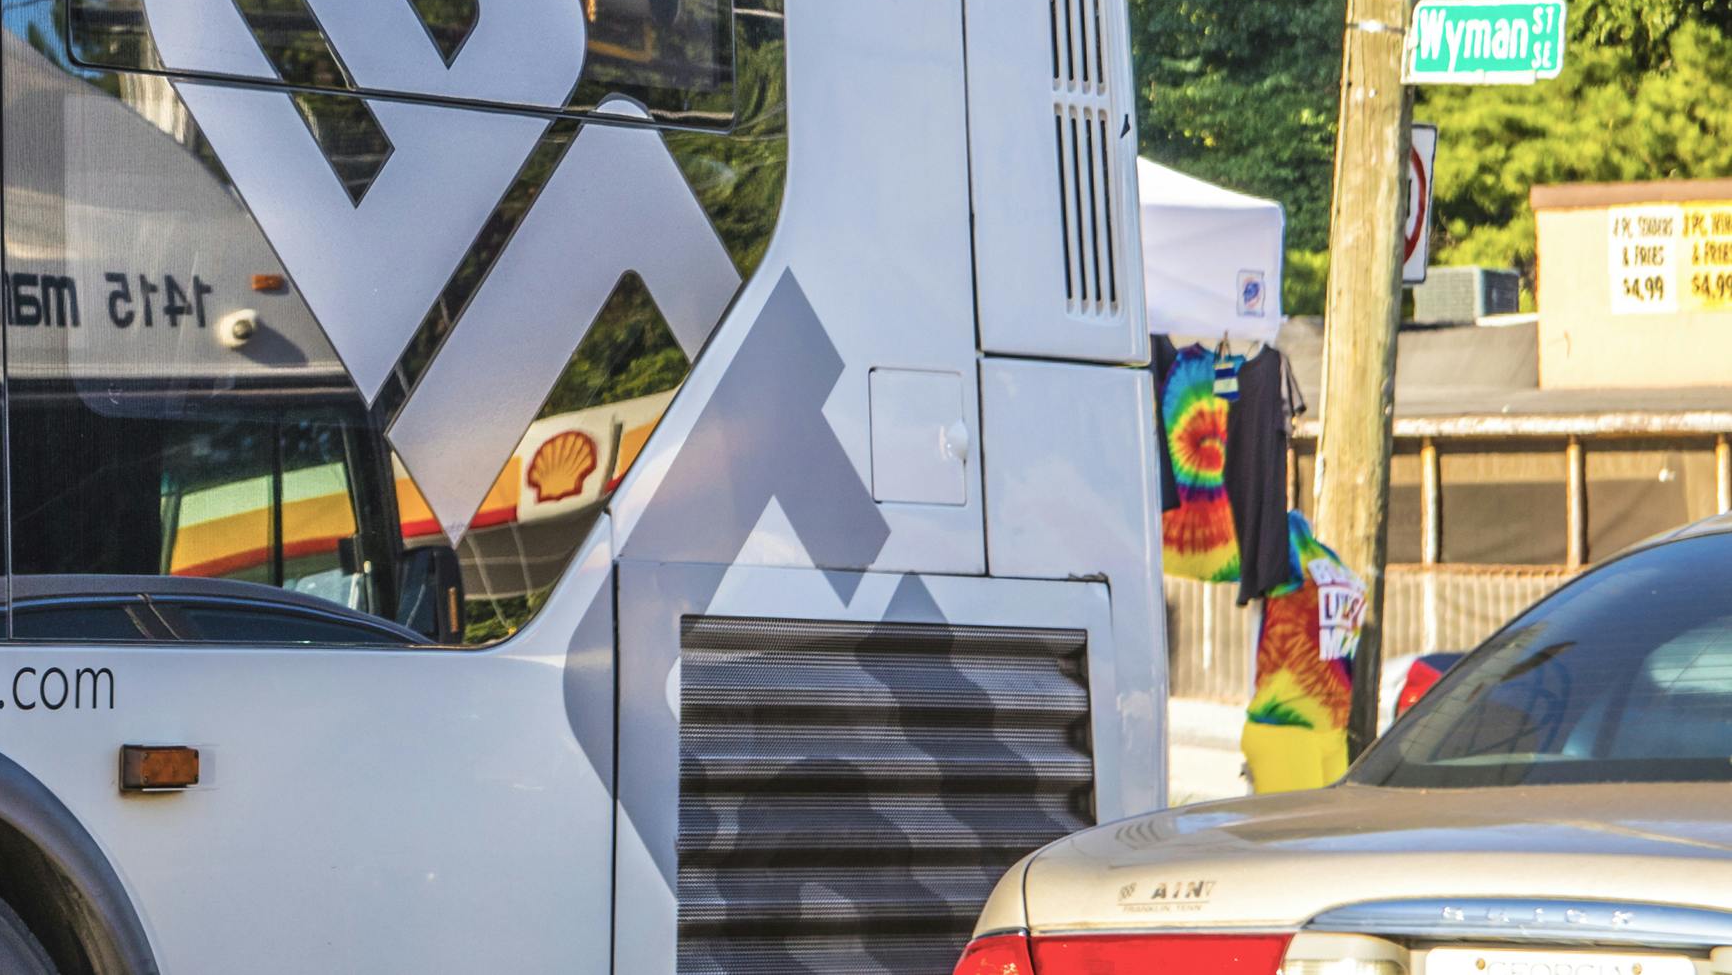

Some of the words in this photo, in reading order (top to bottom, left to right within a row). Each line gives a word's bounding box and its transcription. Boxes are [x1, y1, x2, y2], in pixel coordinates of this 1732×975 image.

[1420, 8, 1528, 74] Wyman
[1532, 6, 1554, 34] ST
[1531, 41, 1552, 69] SE
[1634, 244, 1664, 266] FRIES
